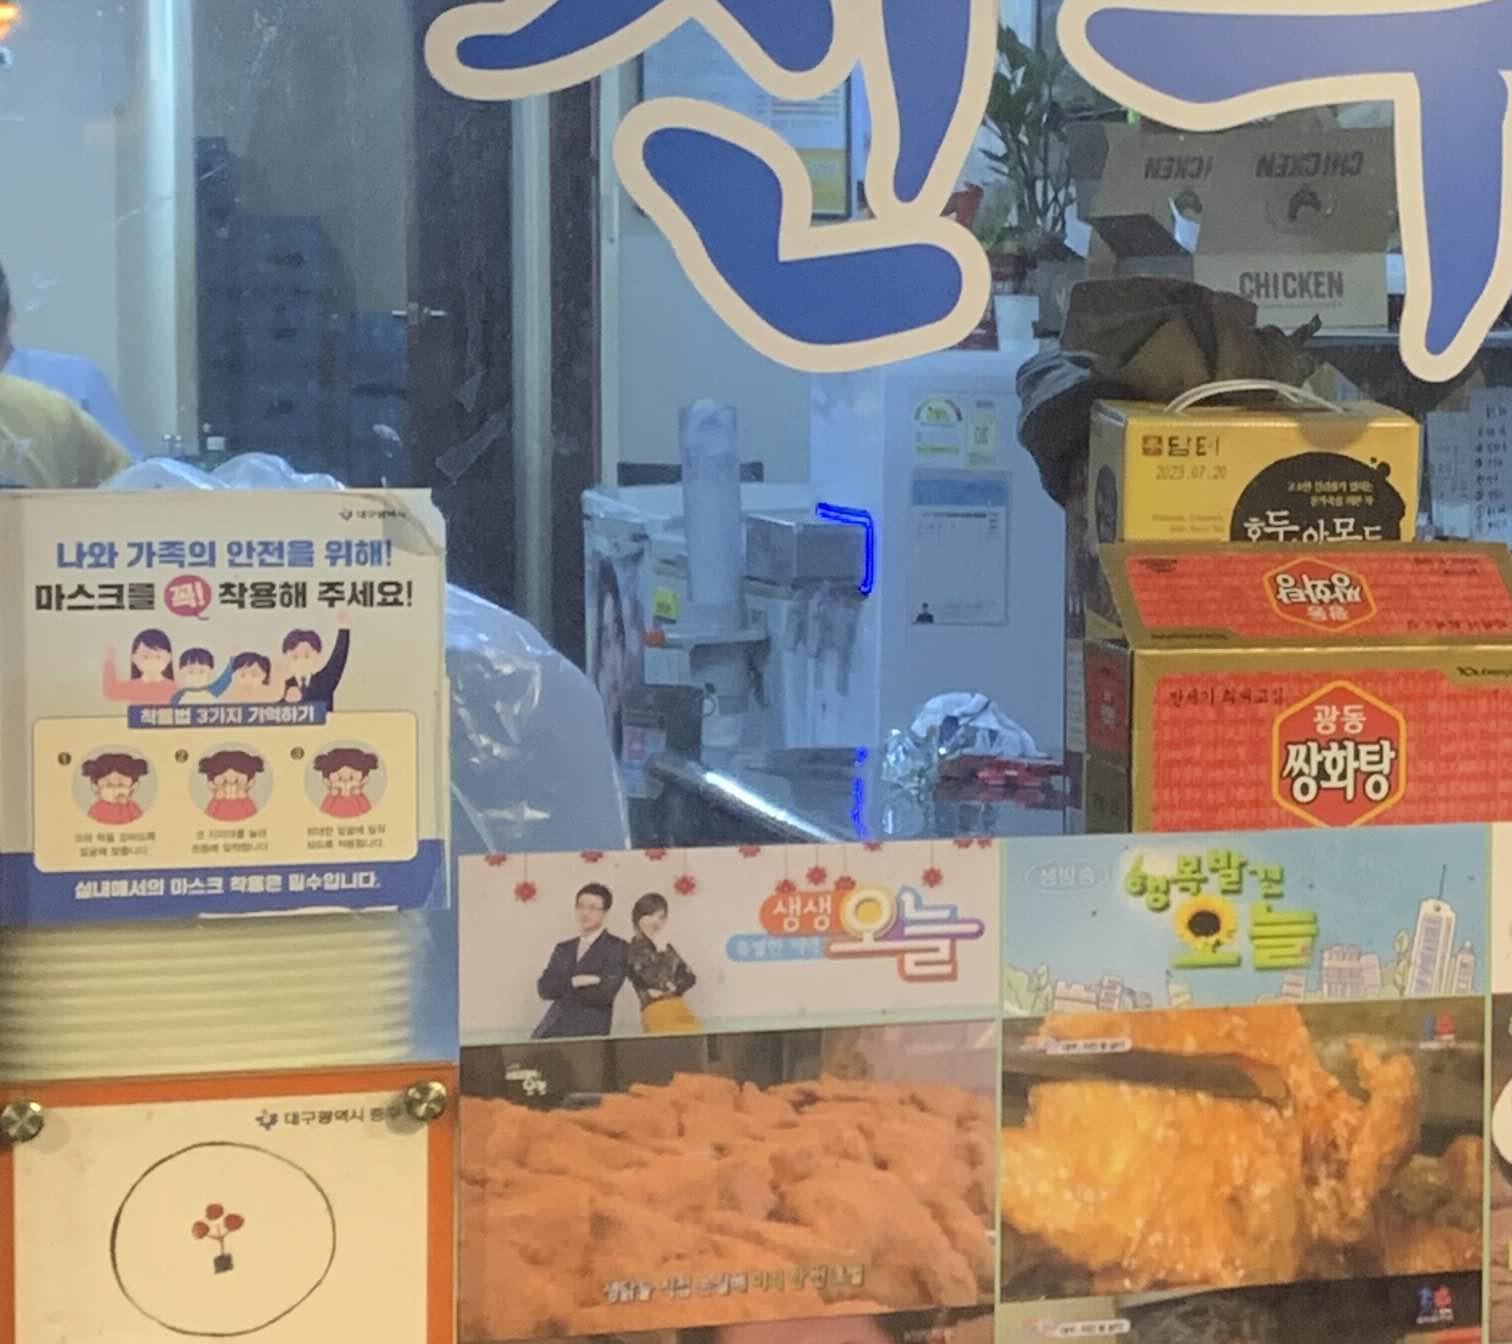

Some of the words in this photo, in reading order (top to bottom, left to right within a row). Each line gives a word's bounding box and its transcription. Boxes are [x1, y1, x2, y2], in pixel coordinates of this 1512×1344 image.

[1239, 271, 1344, 299] CHICKEN
[56, 542, 119, 570] 나와
[126, 541, 218, 569] 가족의
[226, 540, 315, 568] 안전을
[324, 538, 392, 568] 위해!
[34, 582, 156, 612] 마스크를
[218, 581, 308, 610] 착용해
[317, 579, 414, 609] 주세요!
[1313, 704, 1367, 735] 광동
[1282, 737, 1397, 803] 쌍화탕
[170, 876, 225, 896] 마스크
[772, 895, 833, 933] 생생
[283, 1108, 365, 1126] 대구광역시
